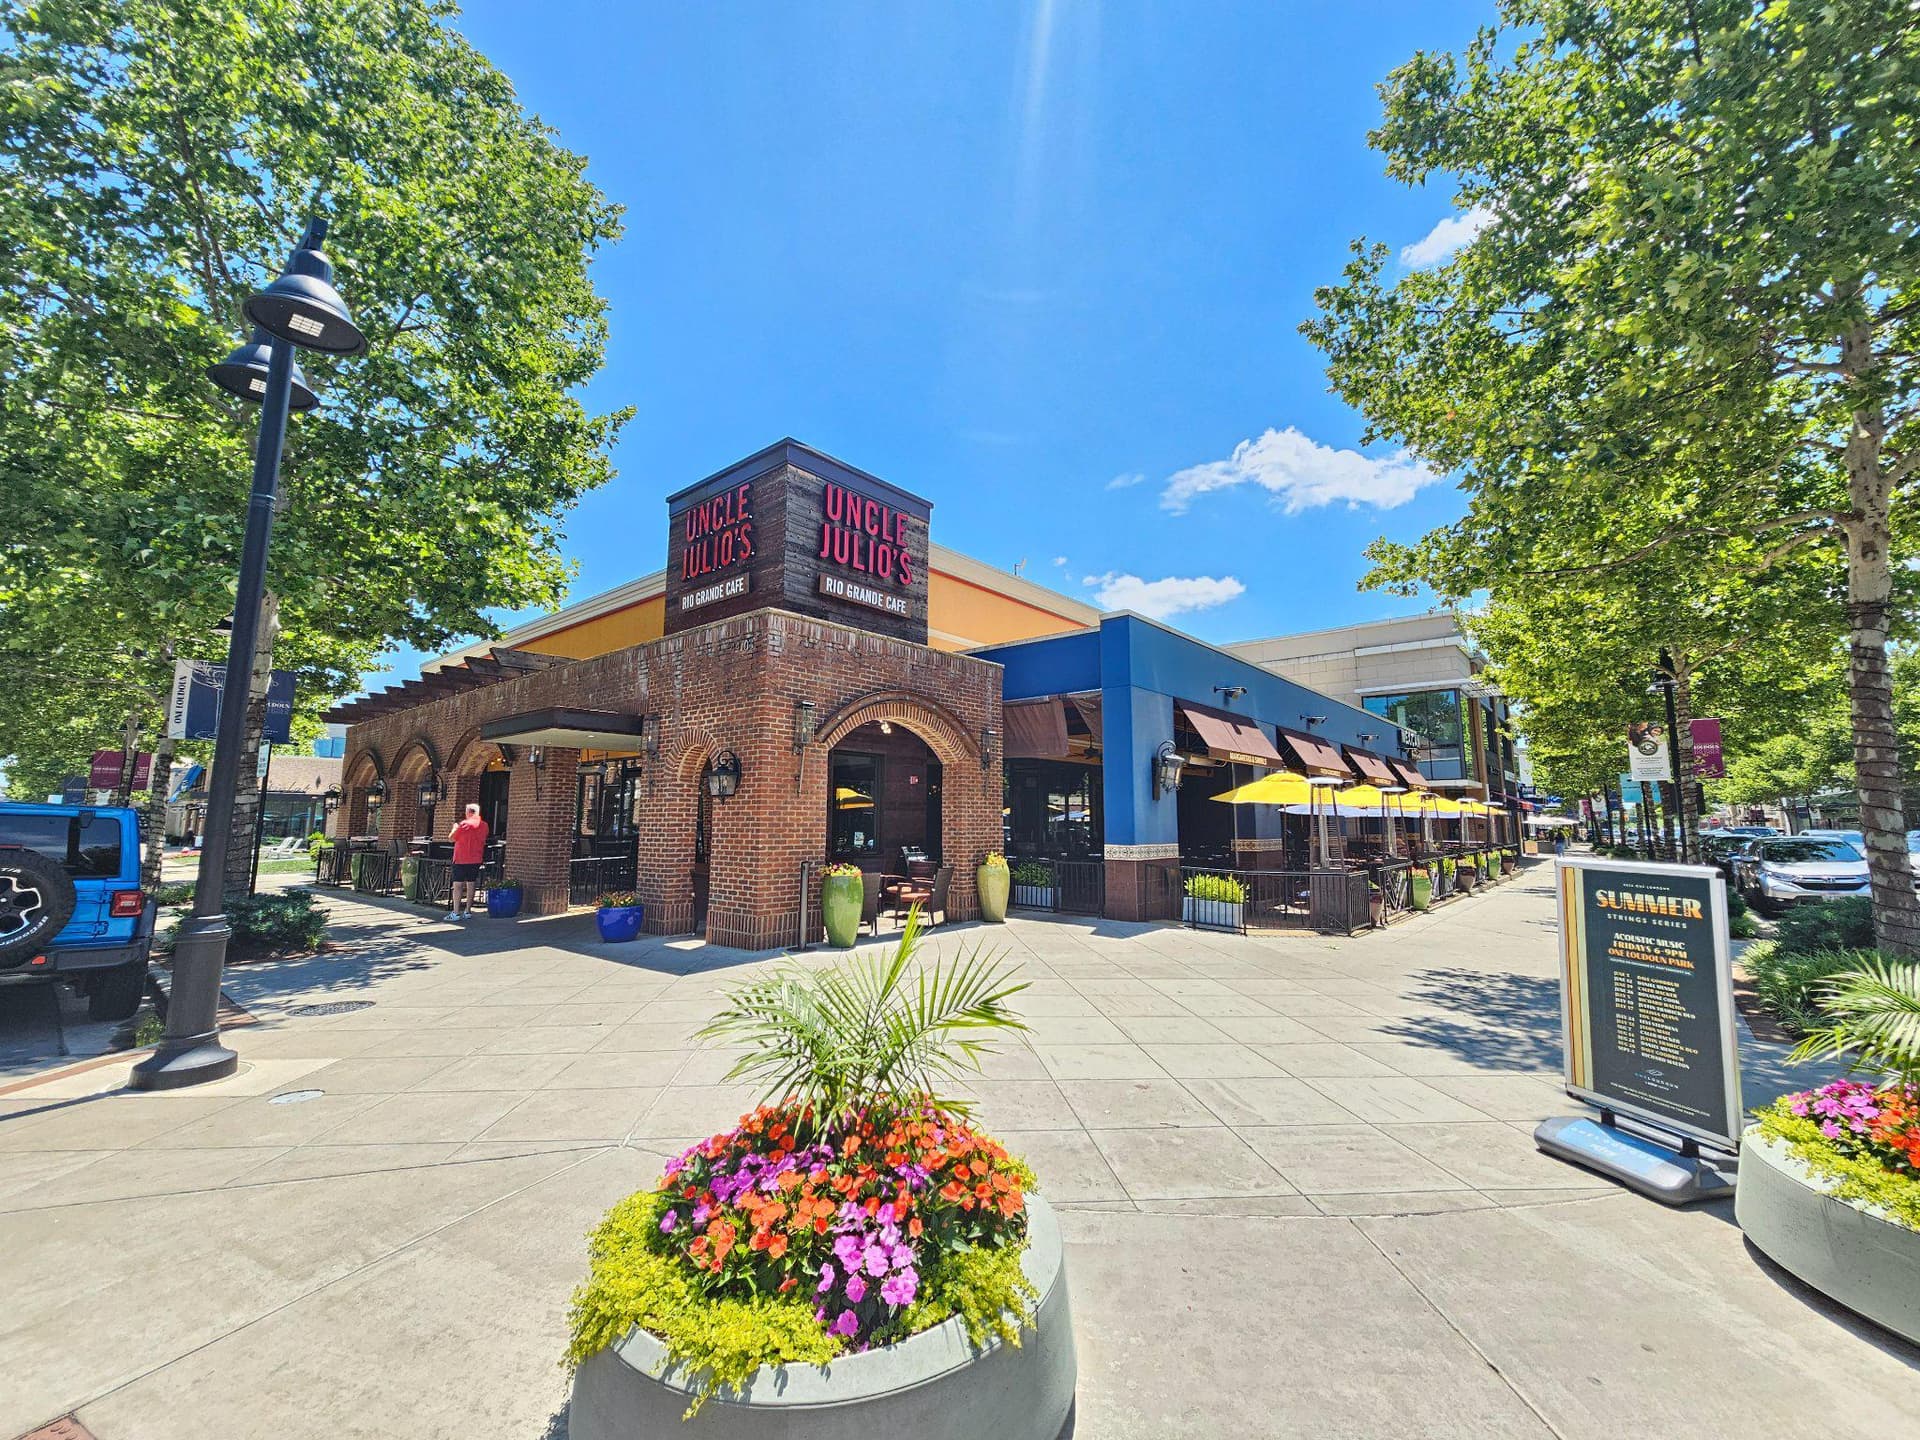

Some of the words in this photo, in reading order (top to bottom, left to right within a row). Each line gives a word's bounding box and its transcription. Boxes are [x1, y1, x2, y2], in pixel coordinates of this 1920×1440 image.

[685, 484, 750, 543] UNCLE
[825, 483, 909, 548] UNCLE
[681, 523, 752, 581] JULIO'S
[820, 523, 913, 586] JULIO'S
[682, 594, 694, 610] RIO
[695, 584, 724, 606] GRANDE
[725, 577, 744, 596] CAFE
[826, 576, 844, 594] RIO
[846, 584, 883, 606] GRANDE
[886, 596, 906, 614] CAFE
[1595, 889, 1703, 919] SUMMER
[1607, 913, 1648, 924] STRINGS
[1652, 919, 1688, 929] SERIES
[1613, 933, 1655, 945] ACOUSTIC
[1656, 938, 1685, 950] MUSIC
[1613, 941, 1652, 953] FRIDAYS
[1653, 947, 1688, 959] 6-9PM
[1608, 948, 1624, 956] ONE
[1626, 950, 1667, 964] LOUDOUN
[1668, 958, 1695, 969] PARK
